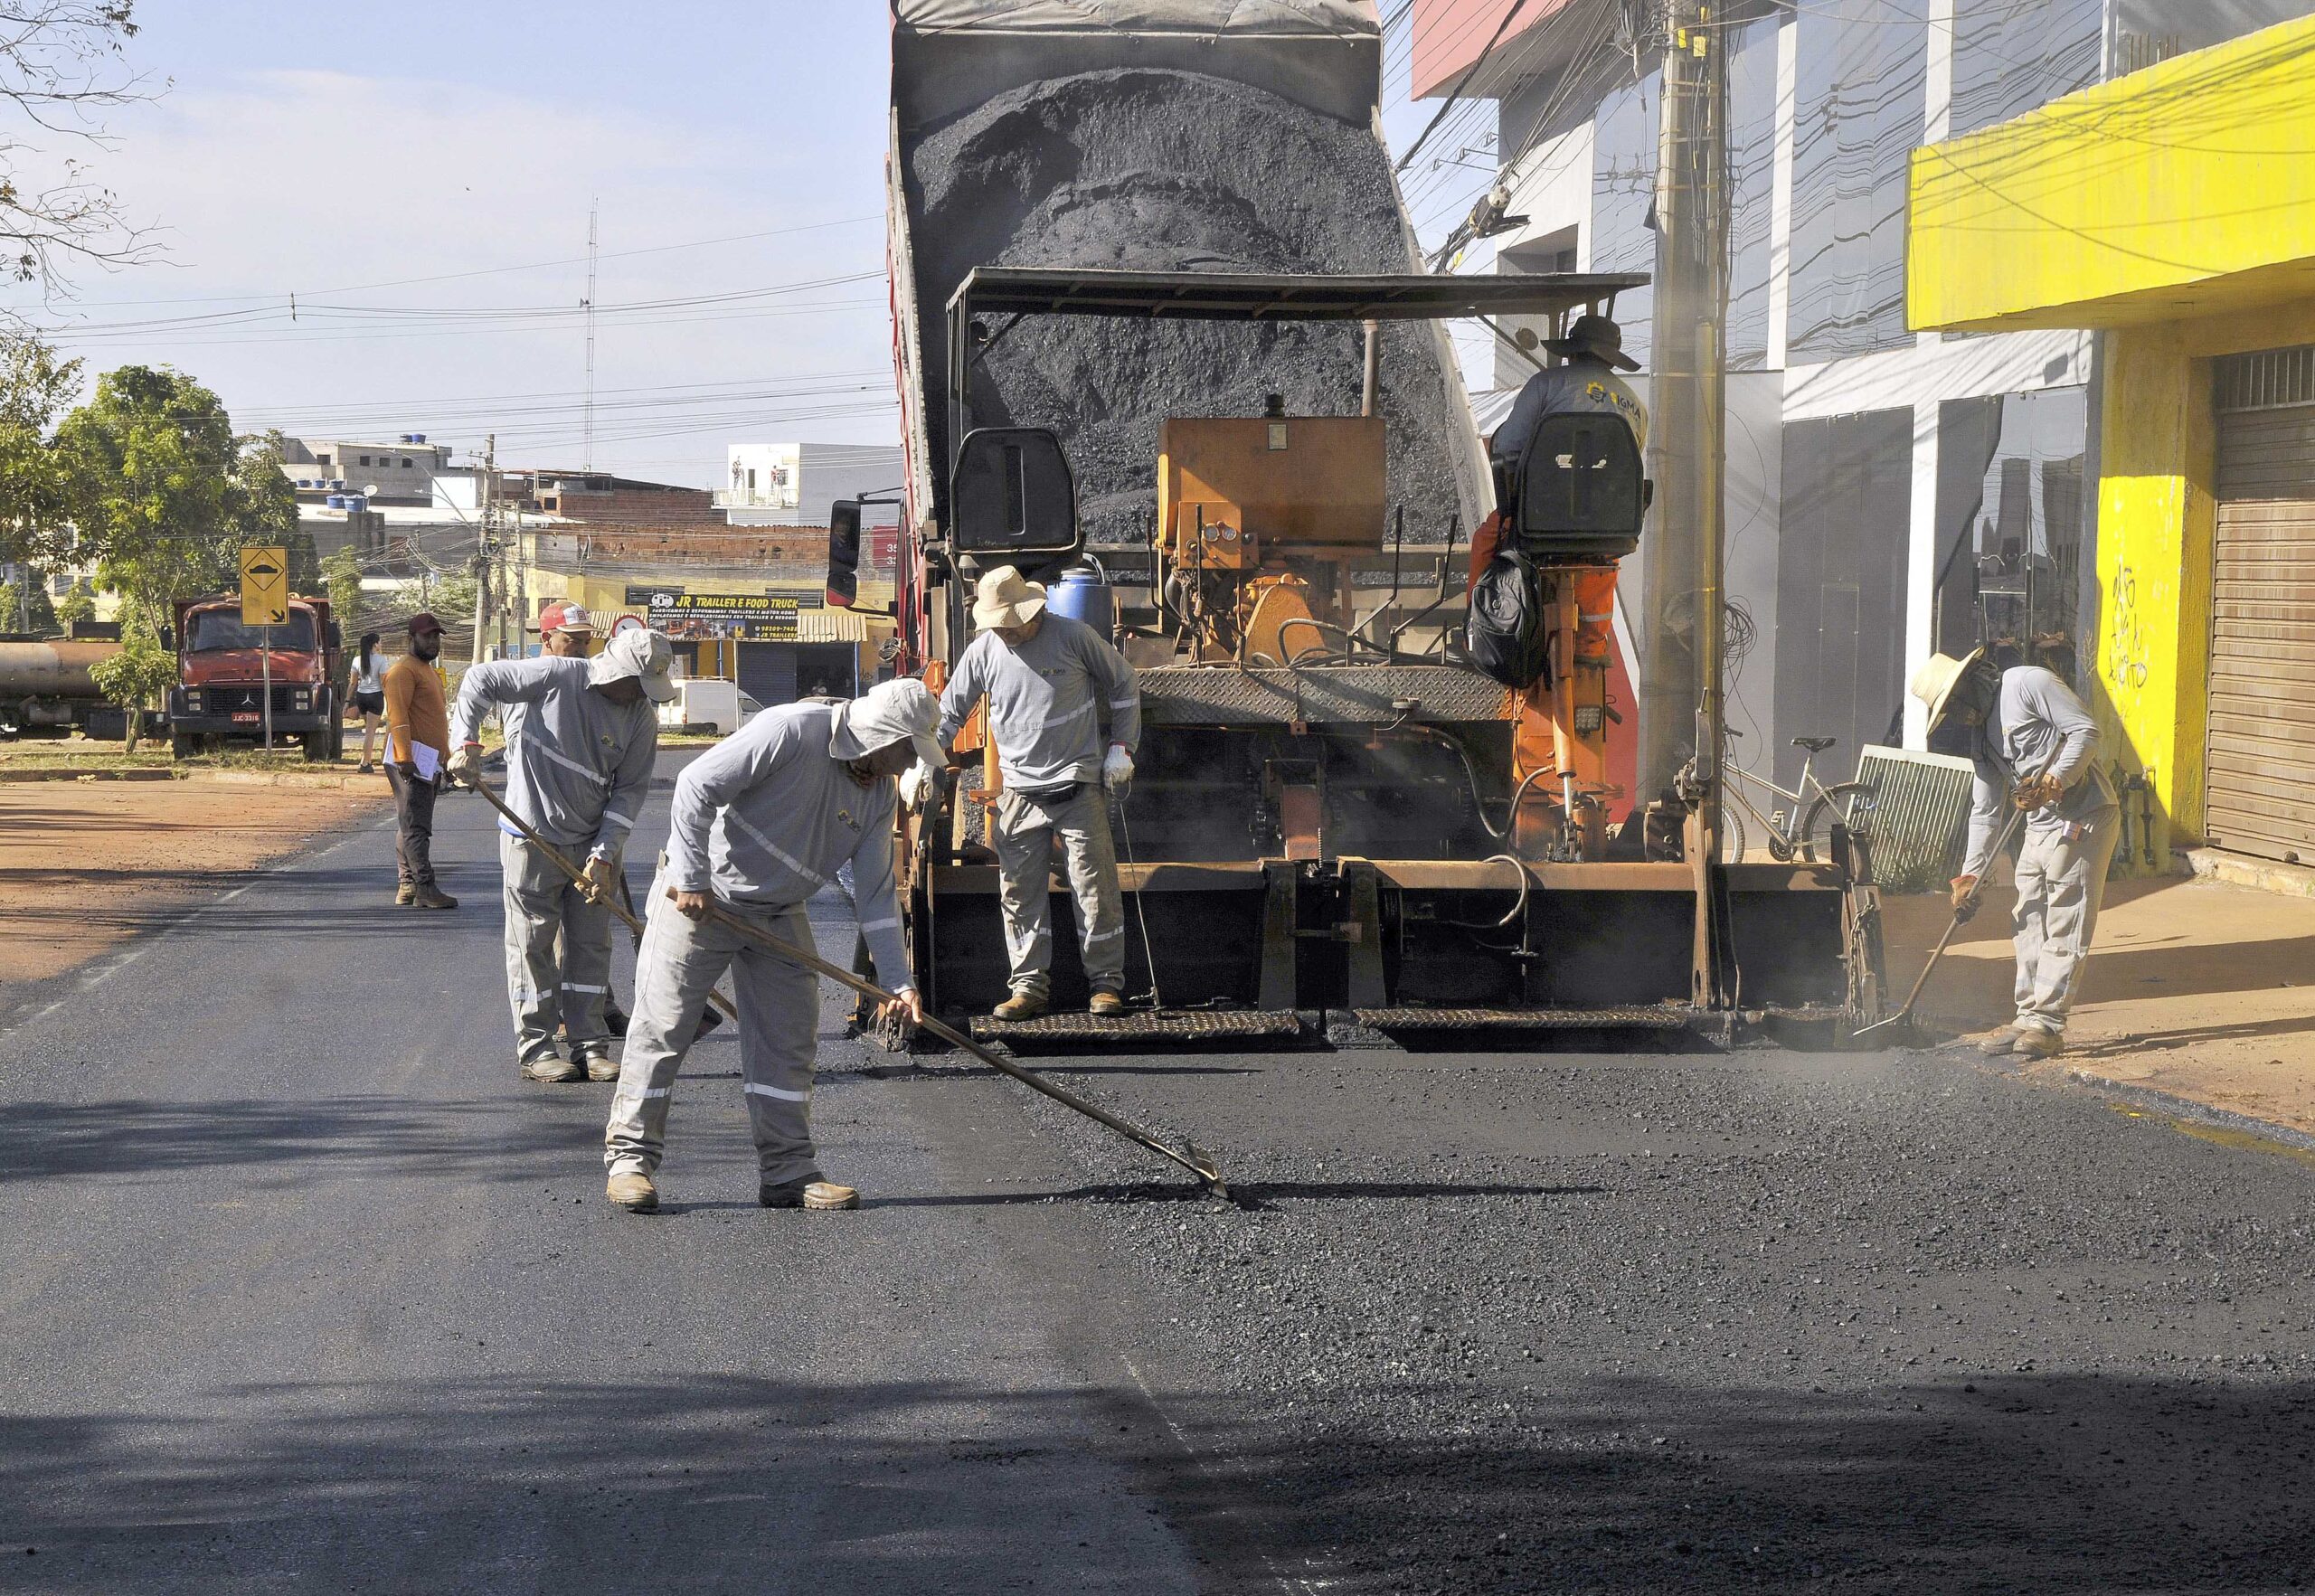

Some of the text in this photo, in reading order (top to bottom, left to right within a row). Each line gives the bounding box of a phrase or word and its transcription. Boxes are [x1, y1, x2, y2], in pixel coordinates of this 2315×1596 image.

[1610, 392, 1640, 419] SIGMA
[676, 596, 798, 609] JR TRAILLER E FOOD TRUCK
